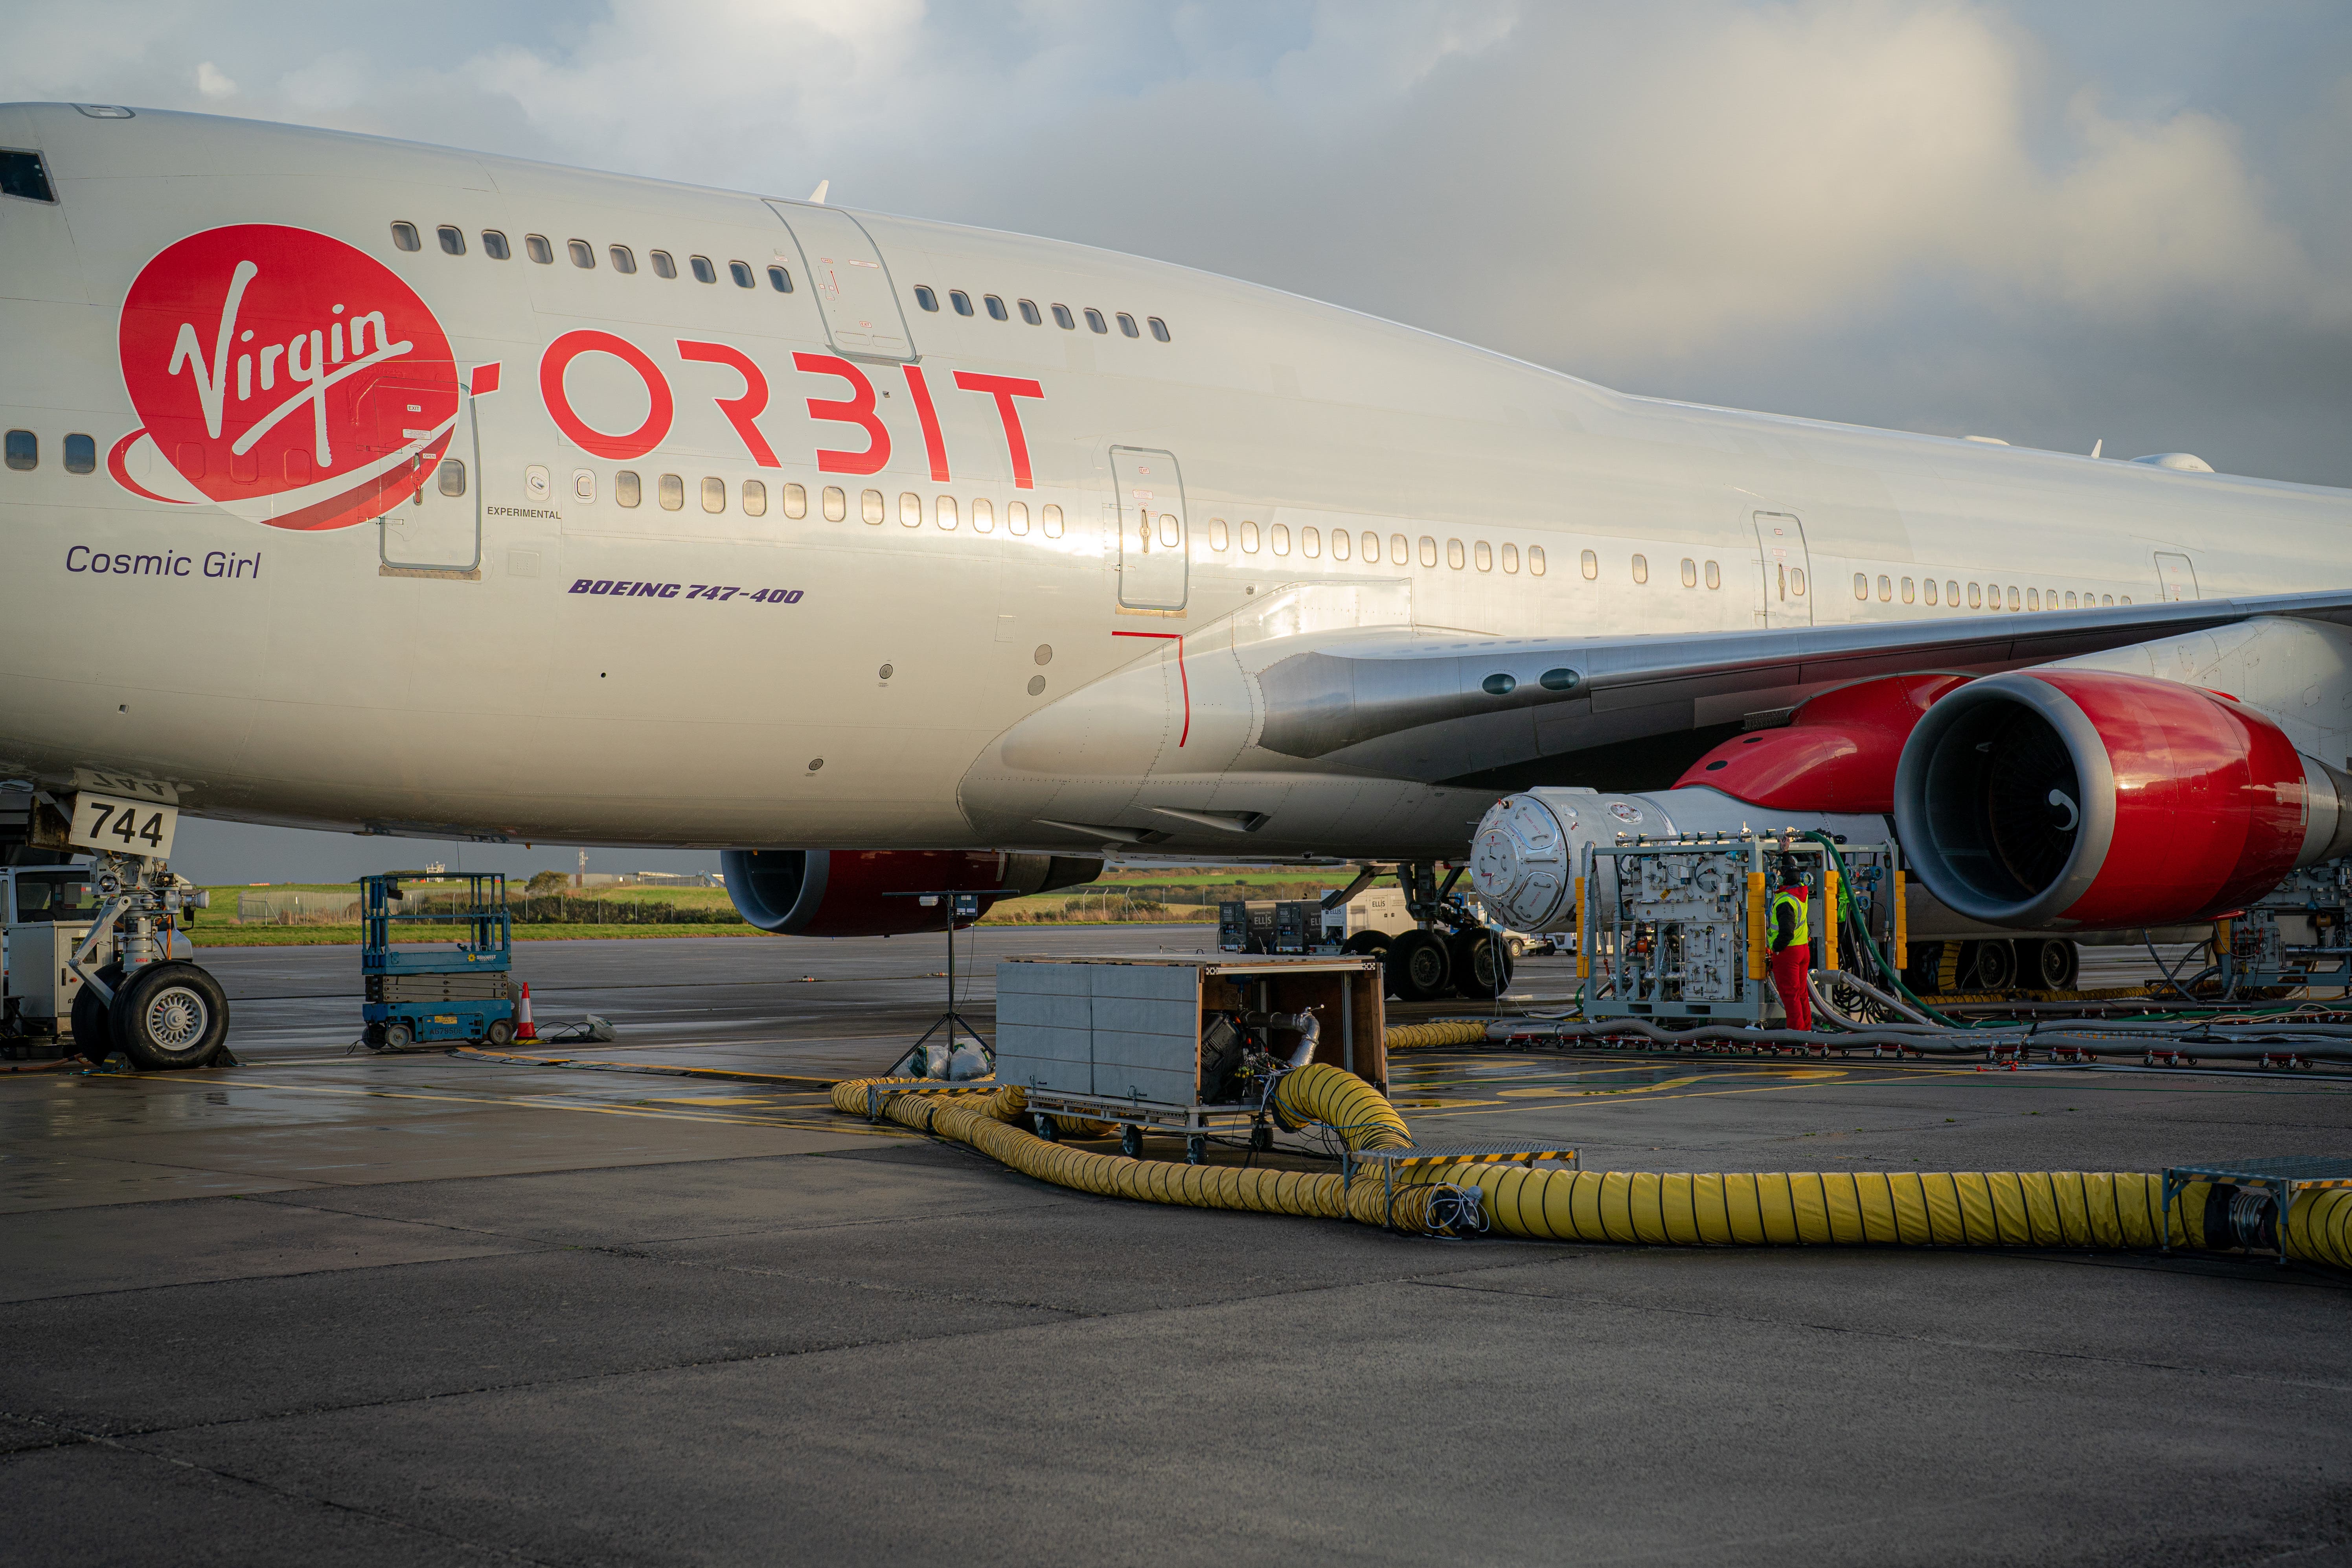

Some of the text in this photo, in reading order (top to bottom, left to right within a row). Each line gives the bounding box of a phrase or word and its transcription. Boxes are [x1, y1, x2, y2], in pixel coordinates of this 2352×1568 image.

[169, 261, 413, 467] Virgin
[540, 329, 1044, 489] ORBIT
[487, 506, 561, 519] EXPERIMENTAL
[66, 546, 261, 579] Cosmic Girl
[568, 579, 804, 604] BOEING 747-400
[90, 802, 163, 848] 744
